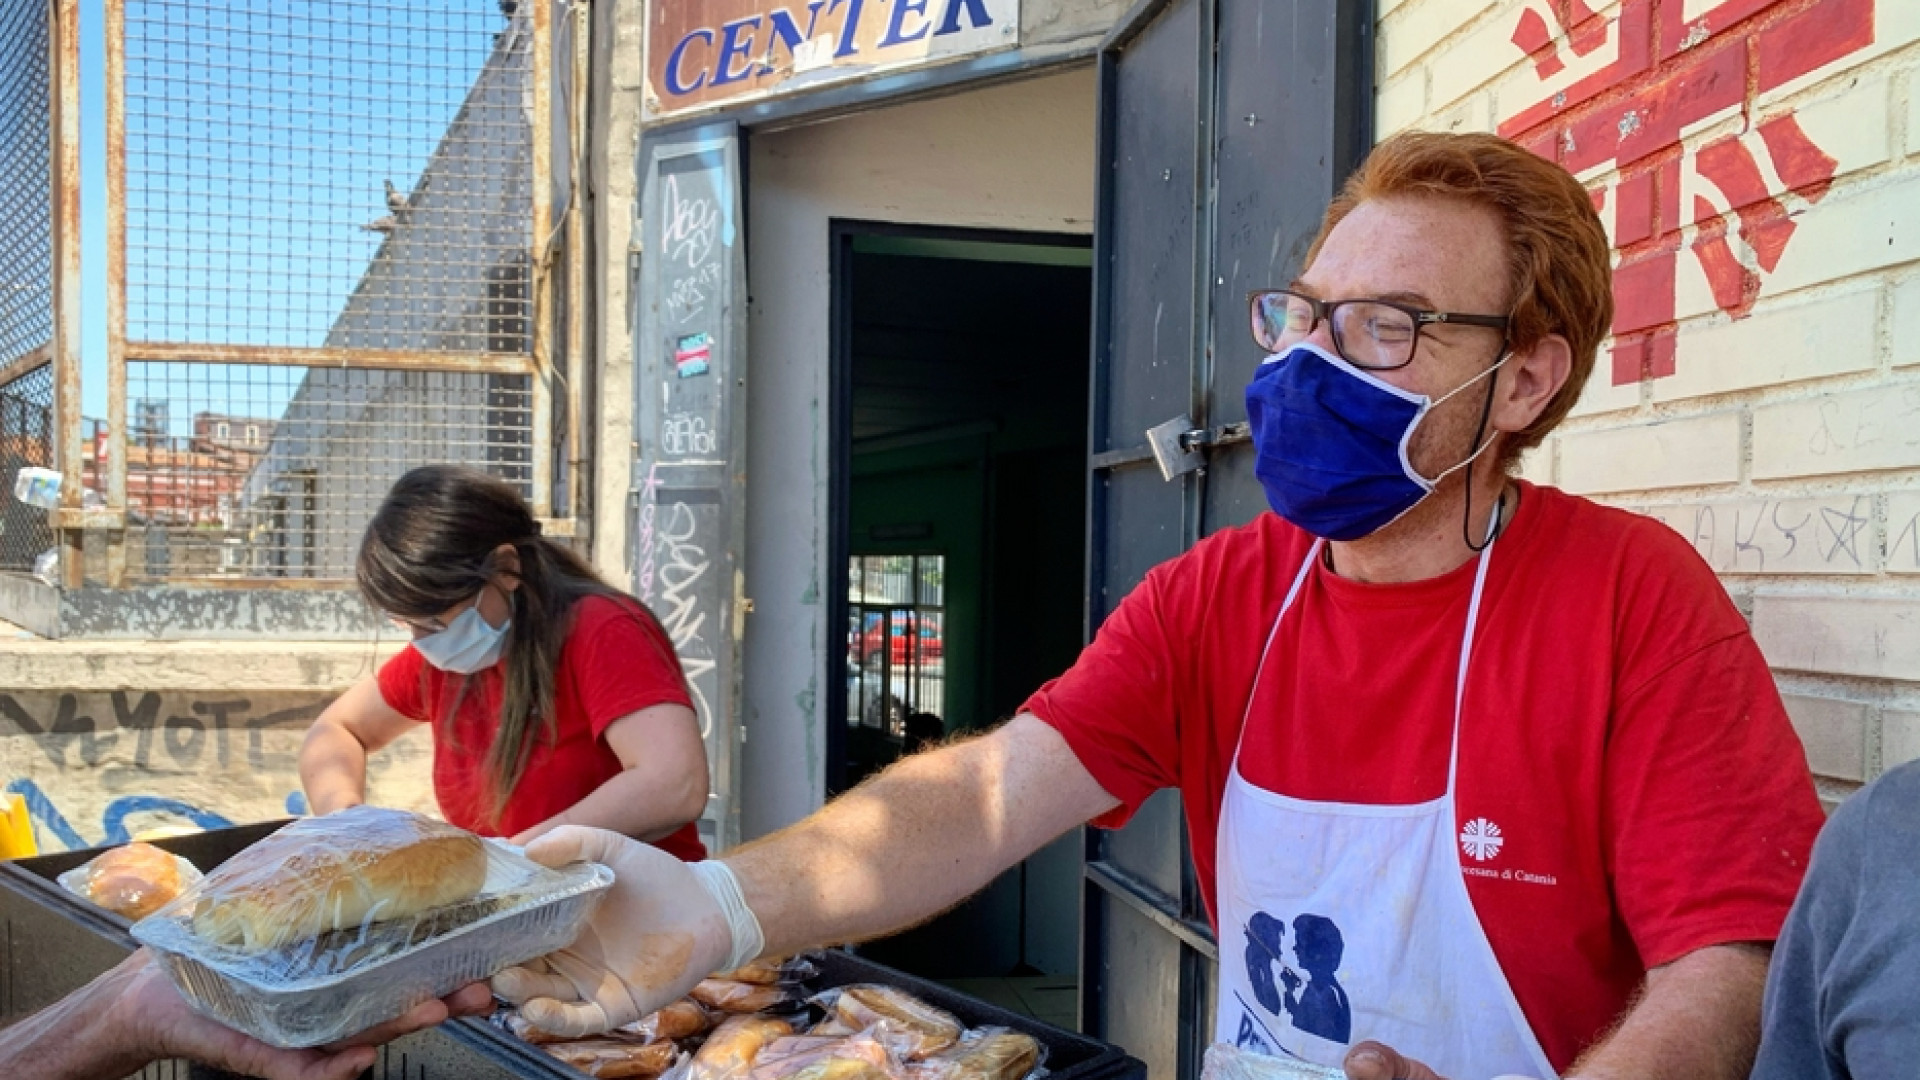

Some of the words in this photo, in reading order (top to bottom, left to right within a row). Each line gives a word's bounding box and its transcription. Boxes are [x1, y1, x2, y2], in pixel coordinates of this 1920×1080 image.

[663, 0, 994, 96] CENTER
[1501, 868, 1511, 880] di
[1514, 869, 1557, 885] Catania
